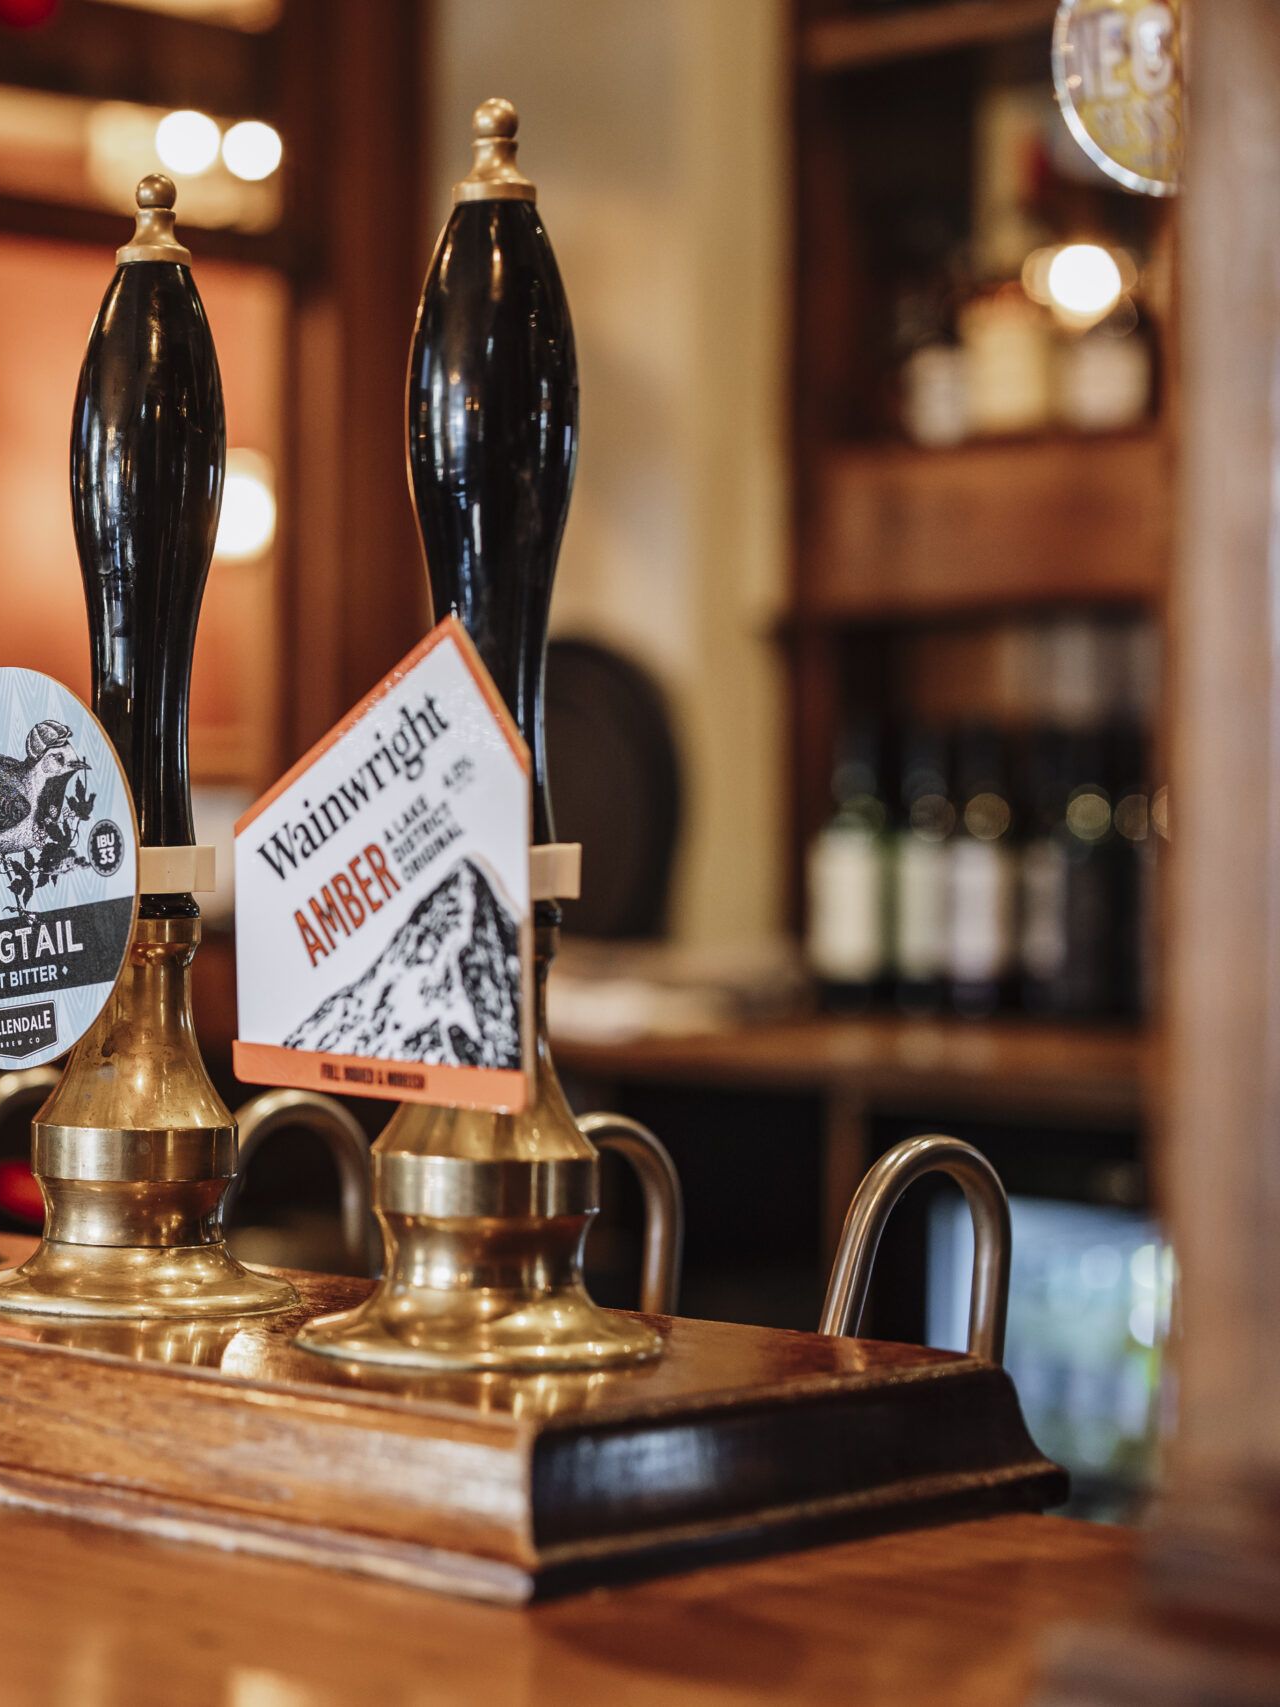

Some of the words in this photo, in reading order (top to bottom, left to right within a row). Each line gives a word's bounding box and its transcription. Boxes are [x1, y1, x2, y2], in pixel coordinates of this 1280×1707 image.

[257, 694, 449, 880] Wainwright
[95, 832, 116, 849] IBU
[98, 846, 116, 865] 33
[294, 842, 402, 967] AMBER
[9, 964, 58, 988] BITTER
[0, 1039, 23, 1049] BREW
[29, 1036, 41, 1045] CO
